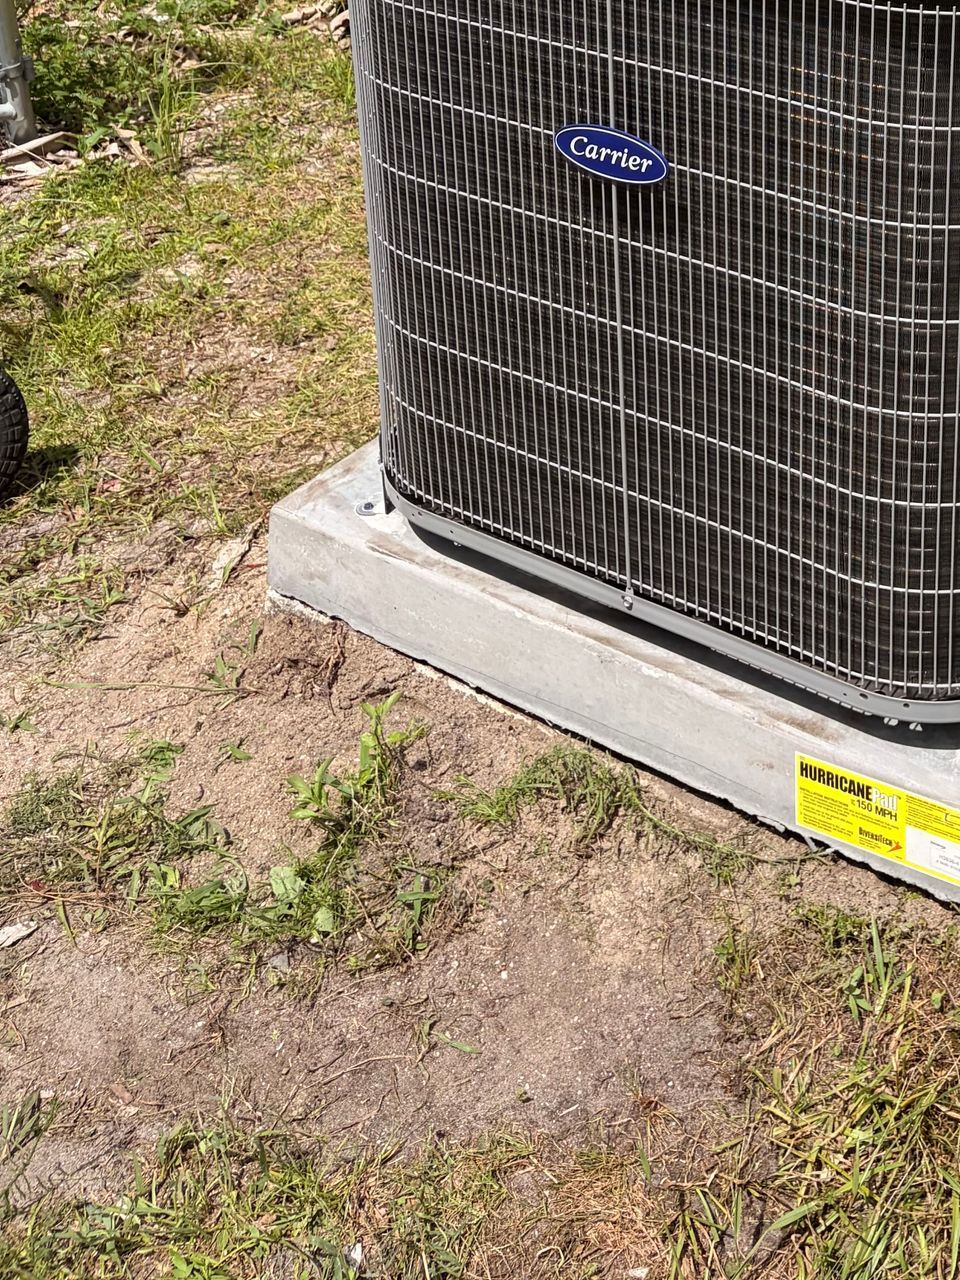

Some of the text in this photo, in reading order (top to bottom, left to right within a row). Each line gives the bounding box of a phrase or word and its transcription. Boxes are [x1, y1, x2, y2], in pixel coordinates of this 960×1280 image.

[570, 136, 653, 173] Carrier
[857, 799, 872, 813] 150
[875, 804, 898, 822] MPH
